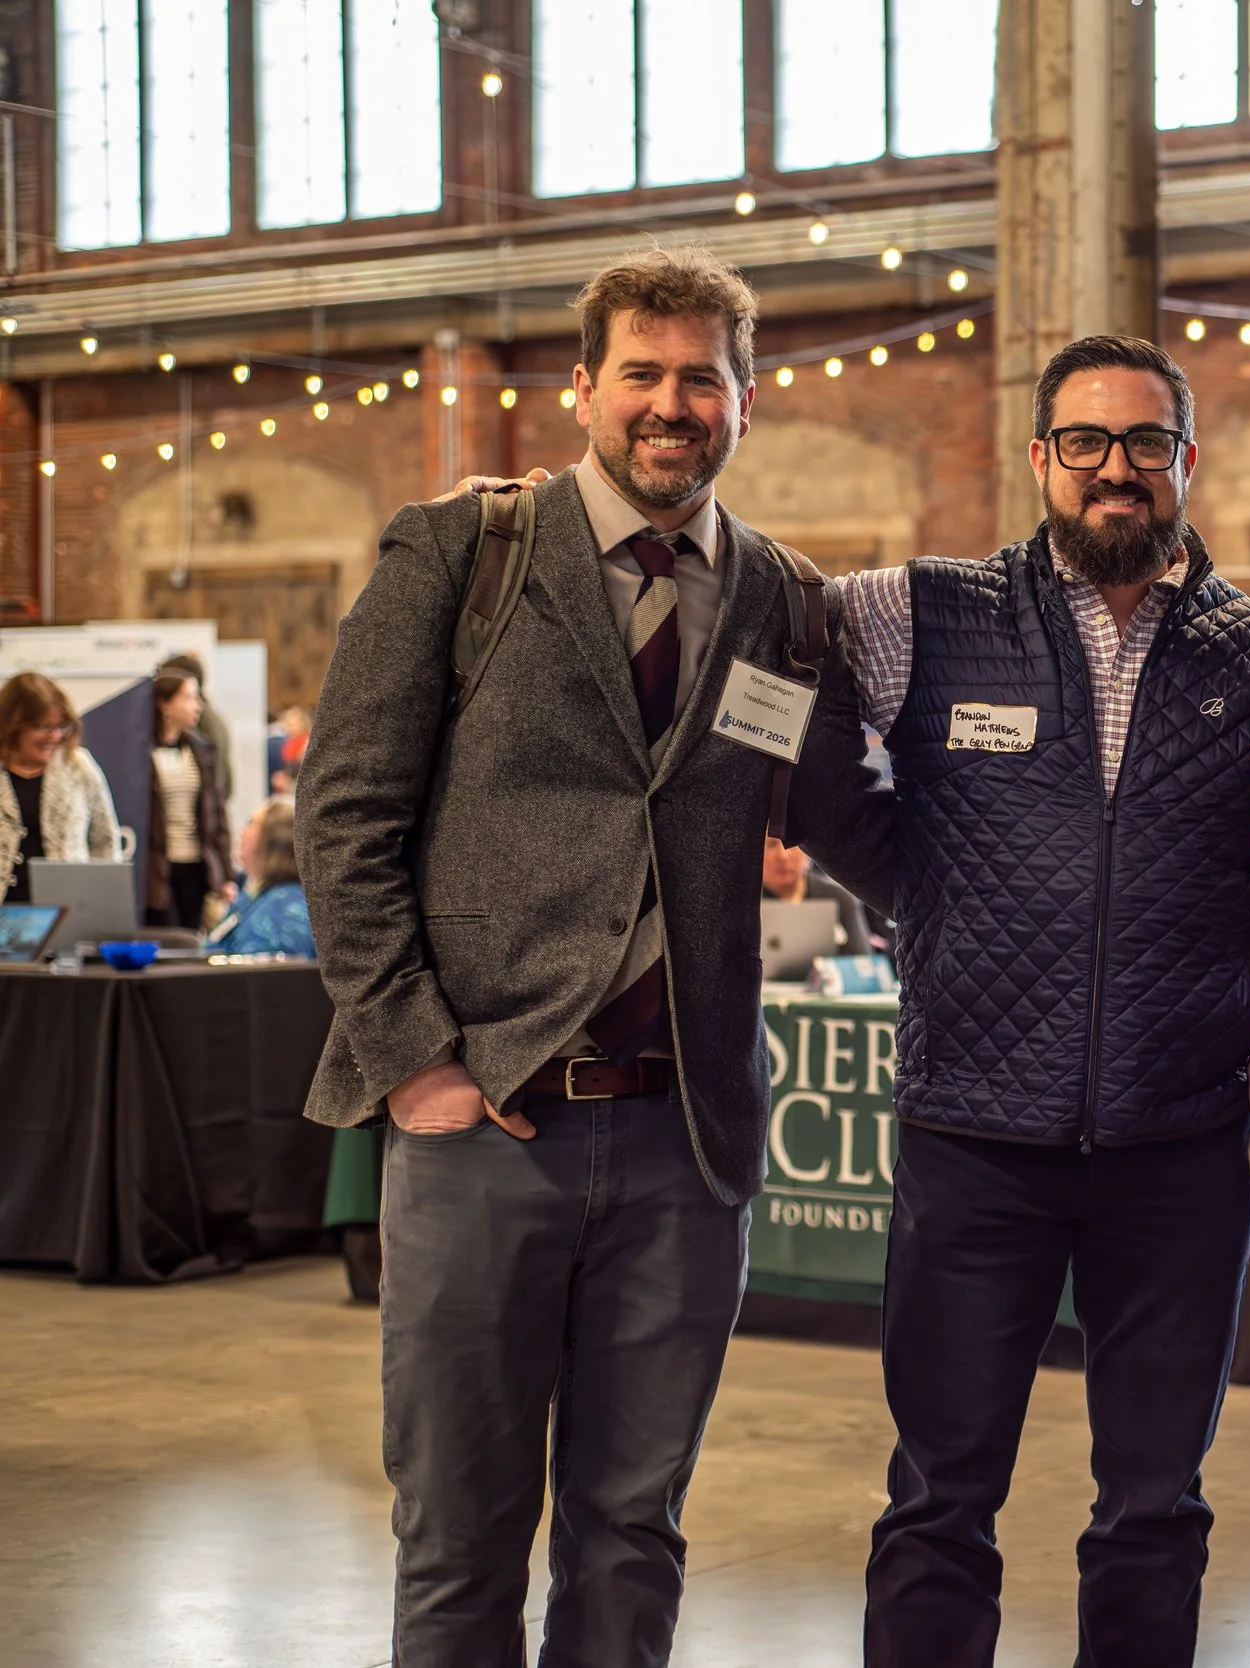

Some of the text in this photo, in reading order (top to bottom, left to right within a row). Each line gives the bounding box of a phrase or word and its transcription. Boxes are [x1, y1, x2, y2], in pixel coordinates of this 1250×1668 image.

[750, 674, 795, 698] Ryan Gahagan
[743, 691, 791, 716] Treadwood LLC
[954, 708, 991, 721] BRANDON
[726, 715, 791, 747] SUMMIT 2026
[950, 737, 964, 747] THE
